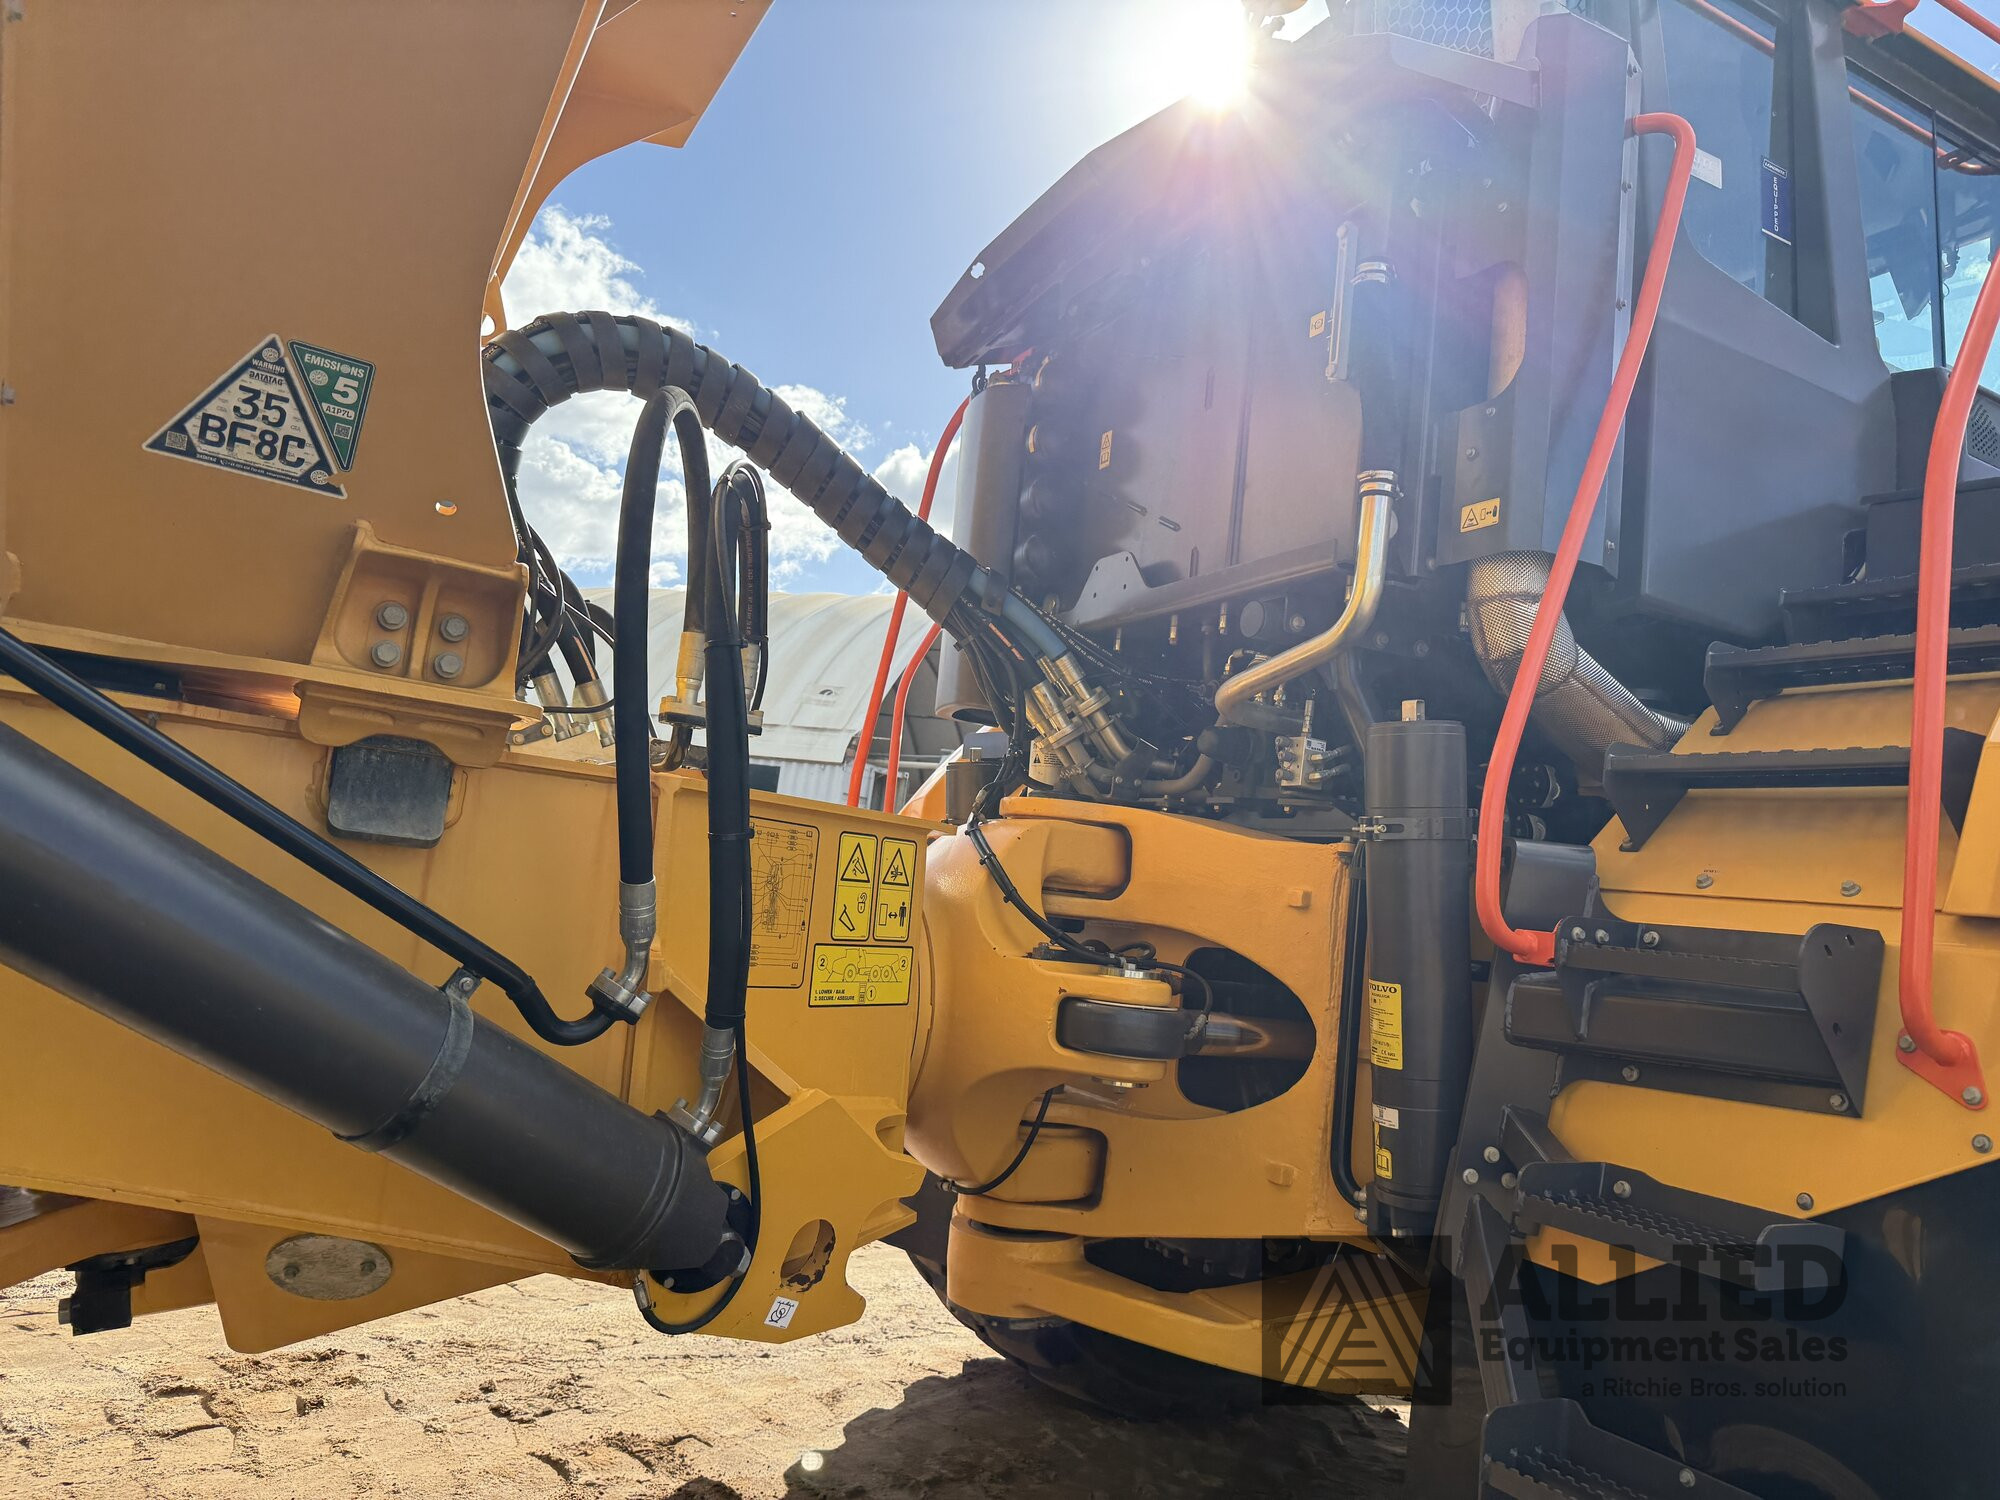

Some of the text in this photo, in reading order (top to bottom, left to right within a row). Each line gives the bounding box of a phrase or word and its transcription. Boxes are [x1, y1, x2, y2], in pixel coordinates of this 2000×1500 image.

[252, 358, 285, 374] WARNING
[304, 353, 365, 378] EMISSIONS
[331, 376, 359, 405] 5
[233, 384, 290, 428] 35
[199, 411, 306, 469] BF8C
[820, 958, 826, 967] 2
[901, 959, 906, 968] 2
[869, 989, 874, 998] 1
